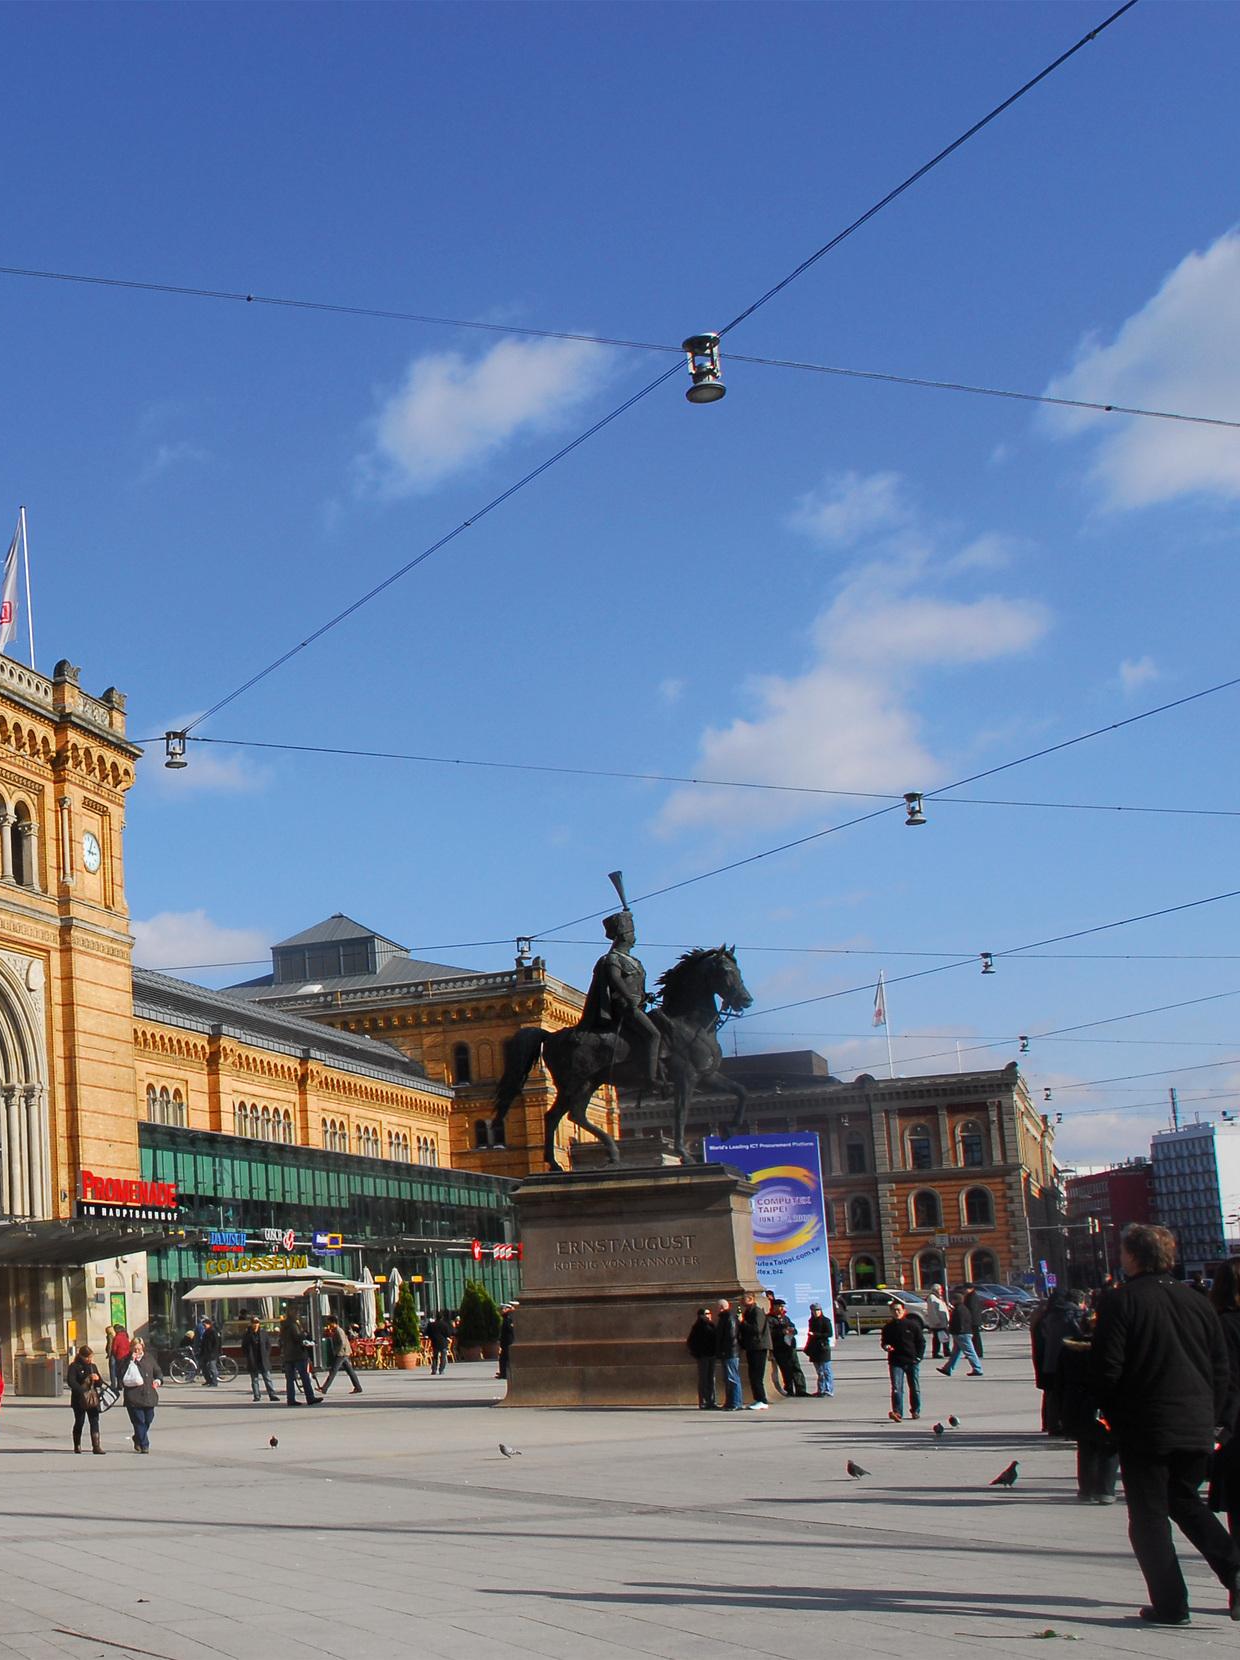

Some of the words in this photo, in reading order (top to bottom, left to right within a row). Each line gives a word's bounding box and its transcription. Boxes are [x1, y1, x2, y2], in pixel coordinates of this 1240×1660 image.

[81, 1170, 177, 1208] PROMENADE
[83, 1205, 95, 1215] IM
[101, 1207, 178, 1220] HAUPTBAHNHOF
[758, 1205, 788, 1213] TAIPEI
[556, 1239, 619, 1255] ERNST
[621, 1234, 696, 1252] AUGUST
[206, 1254, 308, 1274] COLOSSEUM
[554, 1260, 599, 1271] KOENIG
[601, 1258, 626, 1269] VON
[629, 1255, 699, 1268] HANNOVER
[756, 1247, 820, 1266] utexTaipei.com.tw
